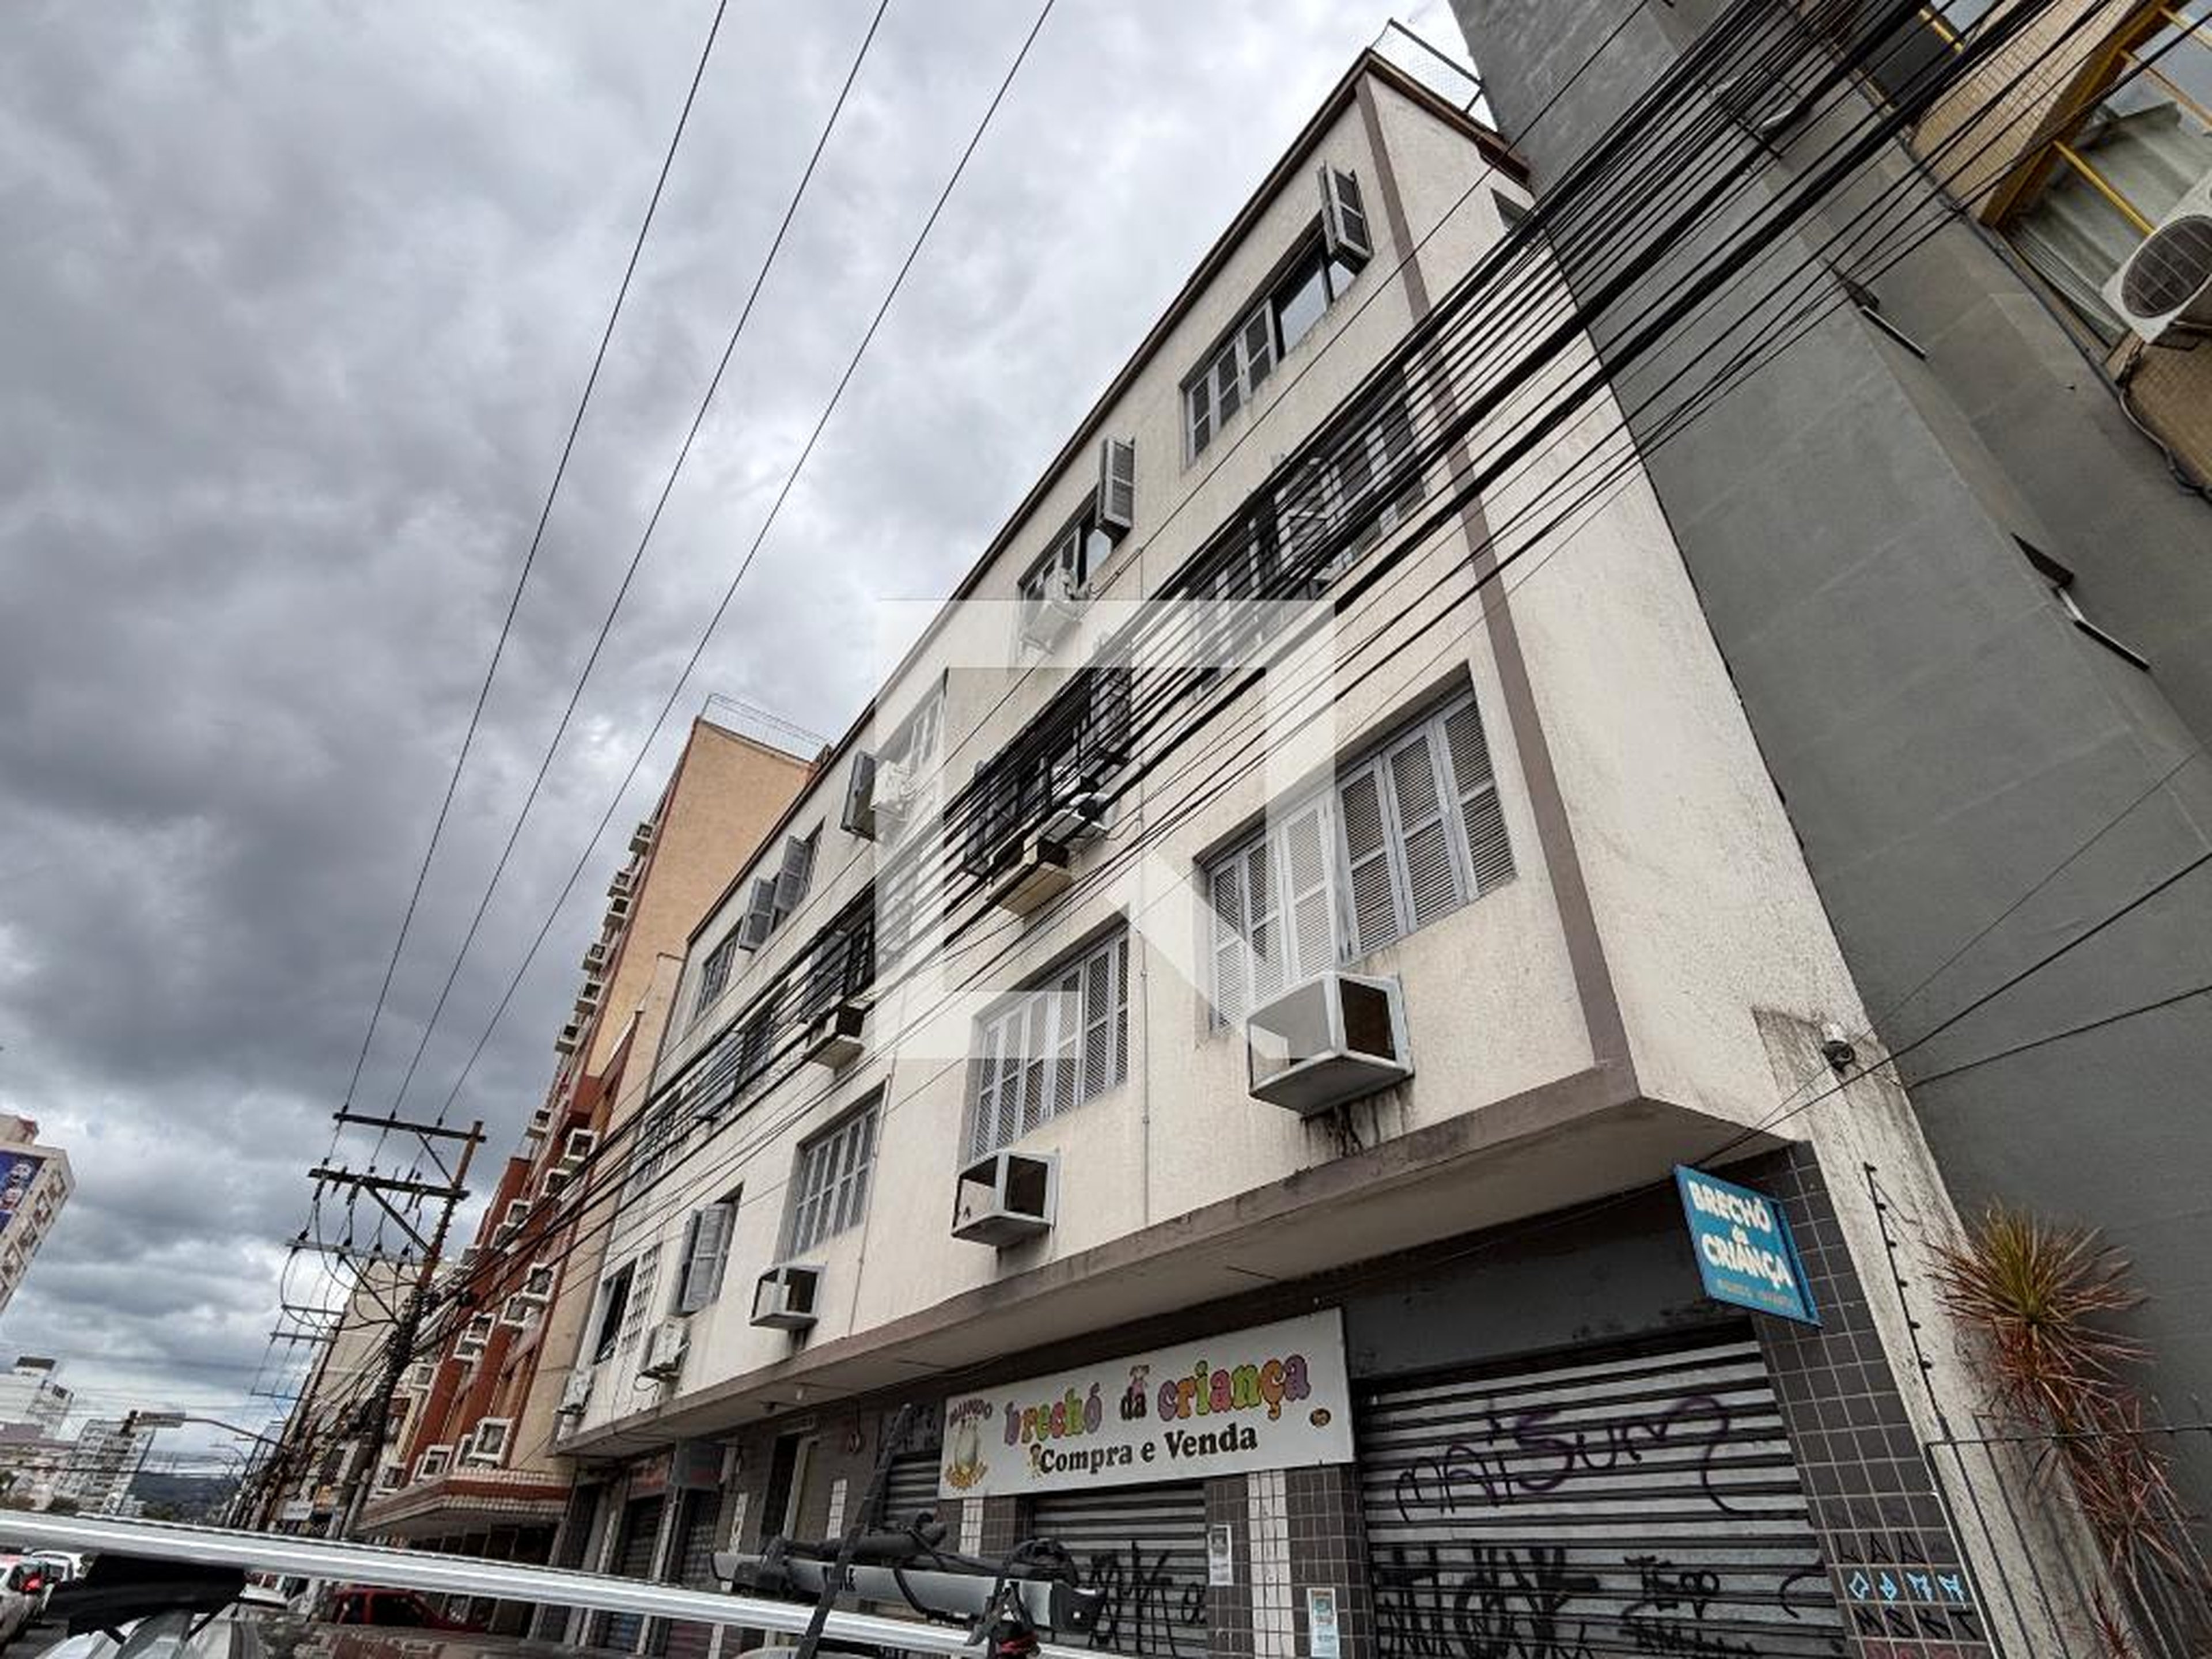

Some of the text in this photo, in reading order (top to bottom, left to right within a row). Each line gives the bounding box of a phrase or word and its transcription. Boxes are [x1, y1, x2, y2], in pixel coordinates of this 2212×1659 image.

[1688, 1181, 1772, 1233] BRECHÓ
[1701, 1233, 1795, 1290] CRIANÇA
[1120, 1382, 1147, 1421] da
[1157, 1354, 1311, 1422] criança
[1040, 1422, 1258, 1475] Compra e Venda
